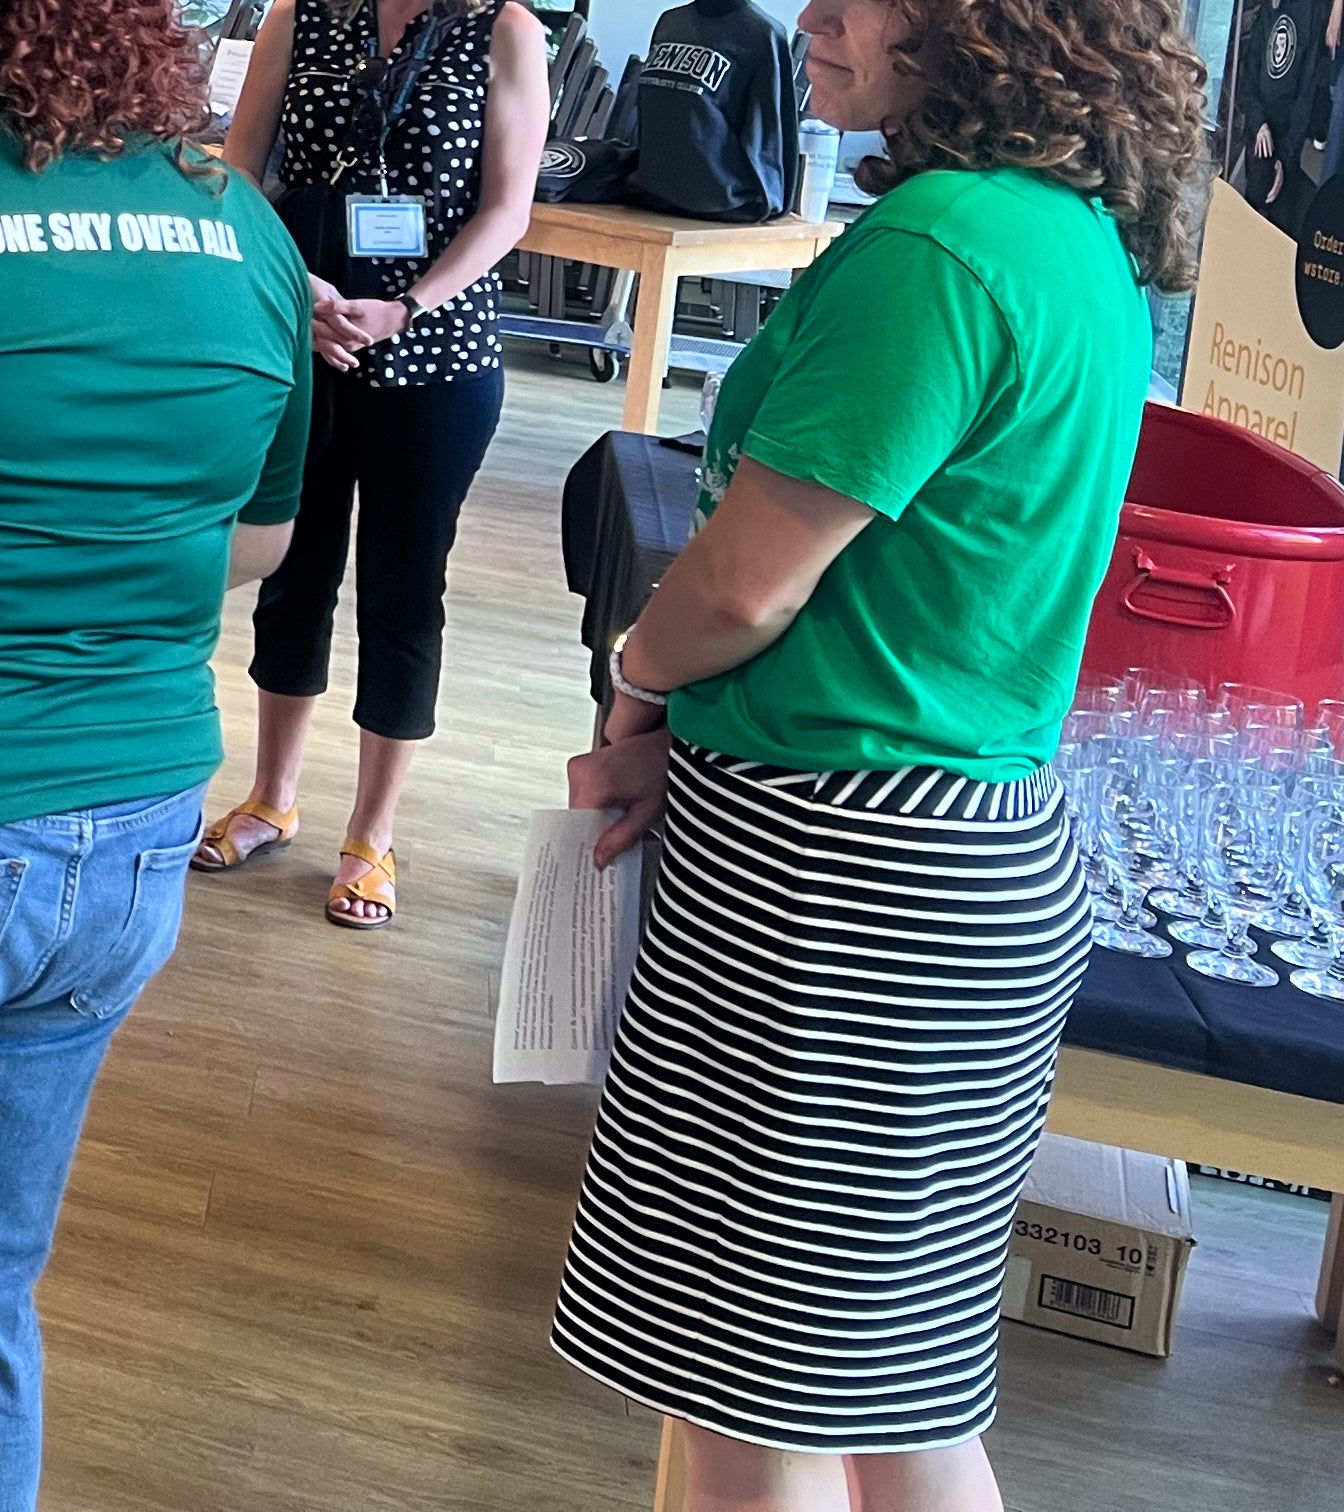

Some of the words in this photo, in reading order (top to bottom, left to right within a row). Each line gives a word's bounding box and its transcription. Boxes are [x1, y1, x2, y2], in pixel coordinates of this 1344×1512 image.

[48, 212, 112, 252] SKY
[117, 212, 201, 254] OVER
[199, 218, 244, 262] ALL
[1209, 321, 1306, 400] Renison
